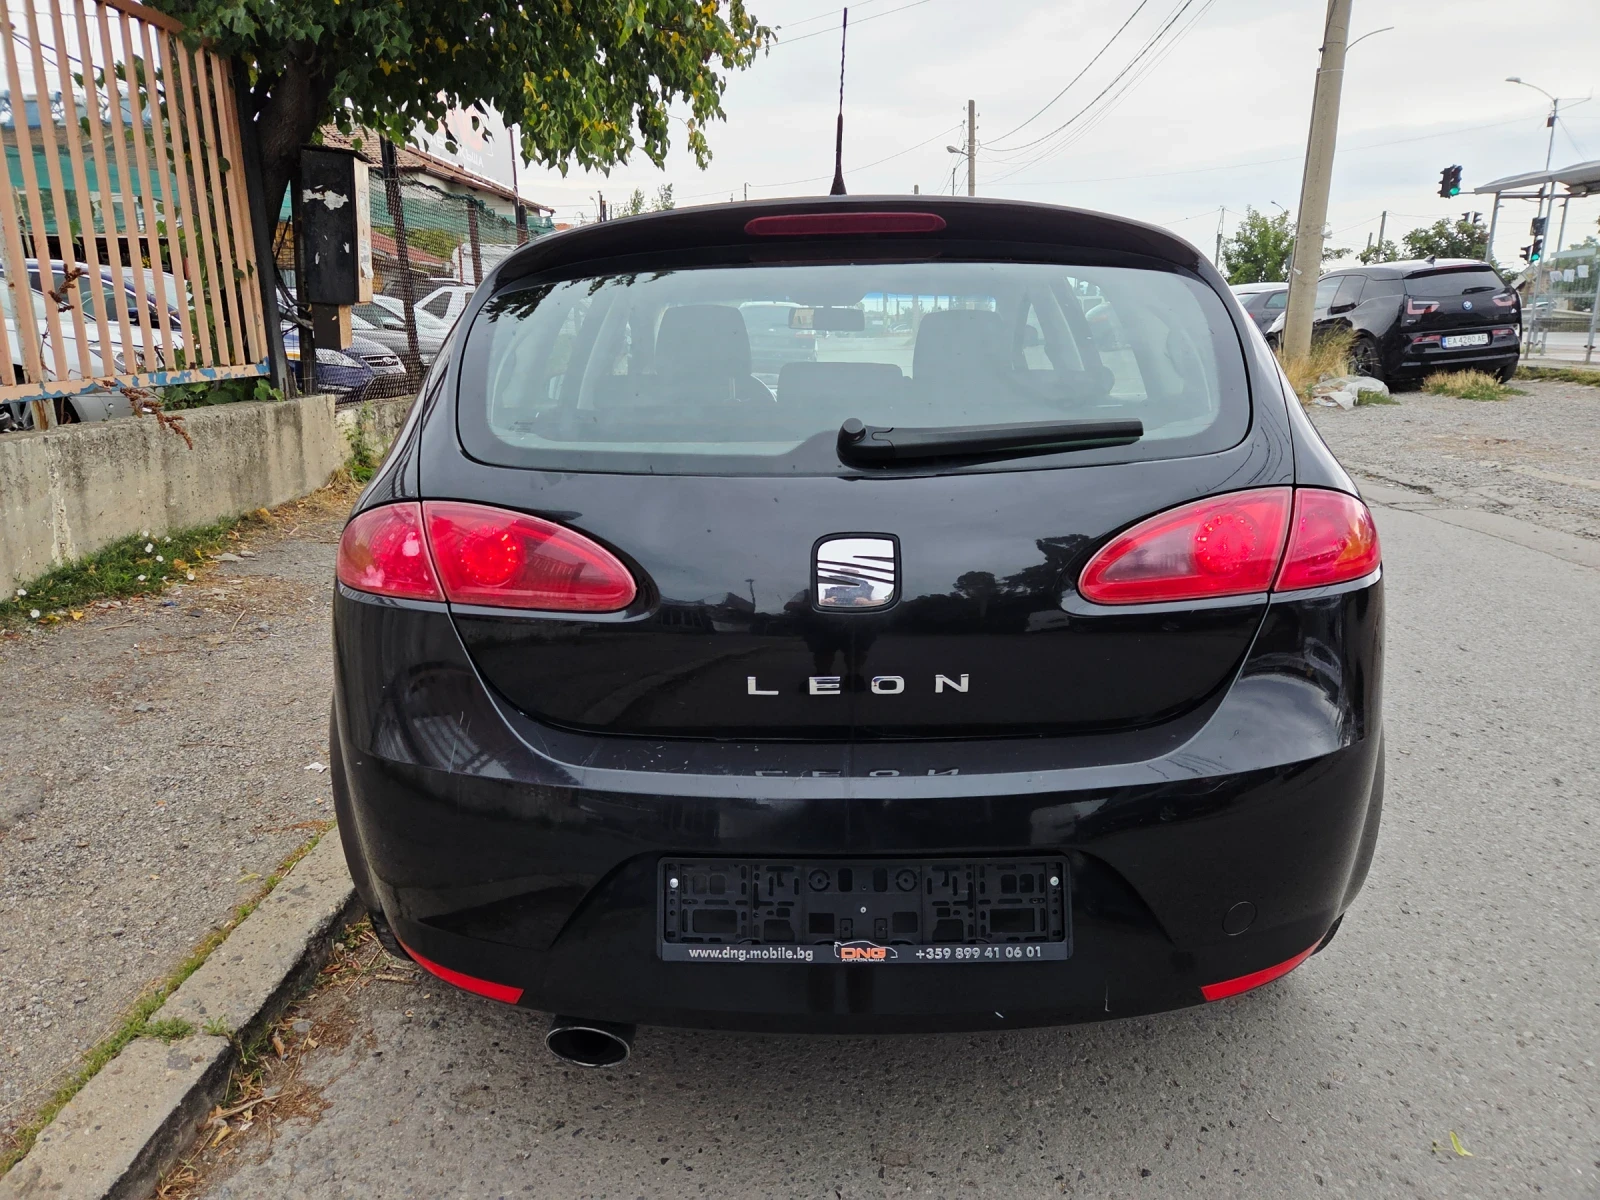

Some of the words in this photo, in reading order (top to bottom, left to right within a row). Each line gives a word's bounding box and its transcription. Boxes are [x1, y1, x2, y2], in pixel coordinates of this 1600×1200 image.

[747, 674, 970, 696] LEON
[689, 946, 814, 961] www.dng.mobile.bg
[841, 947, 886, 959] DNG
[915, 947, 951, 960] +359
[955, 947, 981, 960] 899
[984, 946, 1000, 959] 41
[1005, 946, 1023, 959] 06
[1026, 945, 1042, 958] 01
